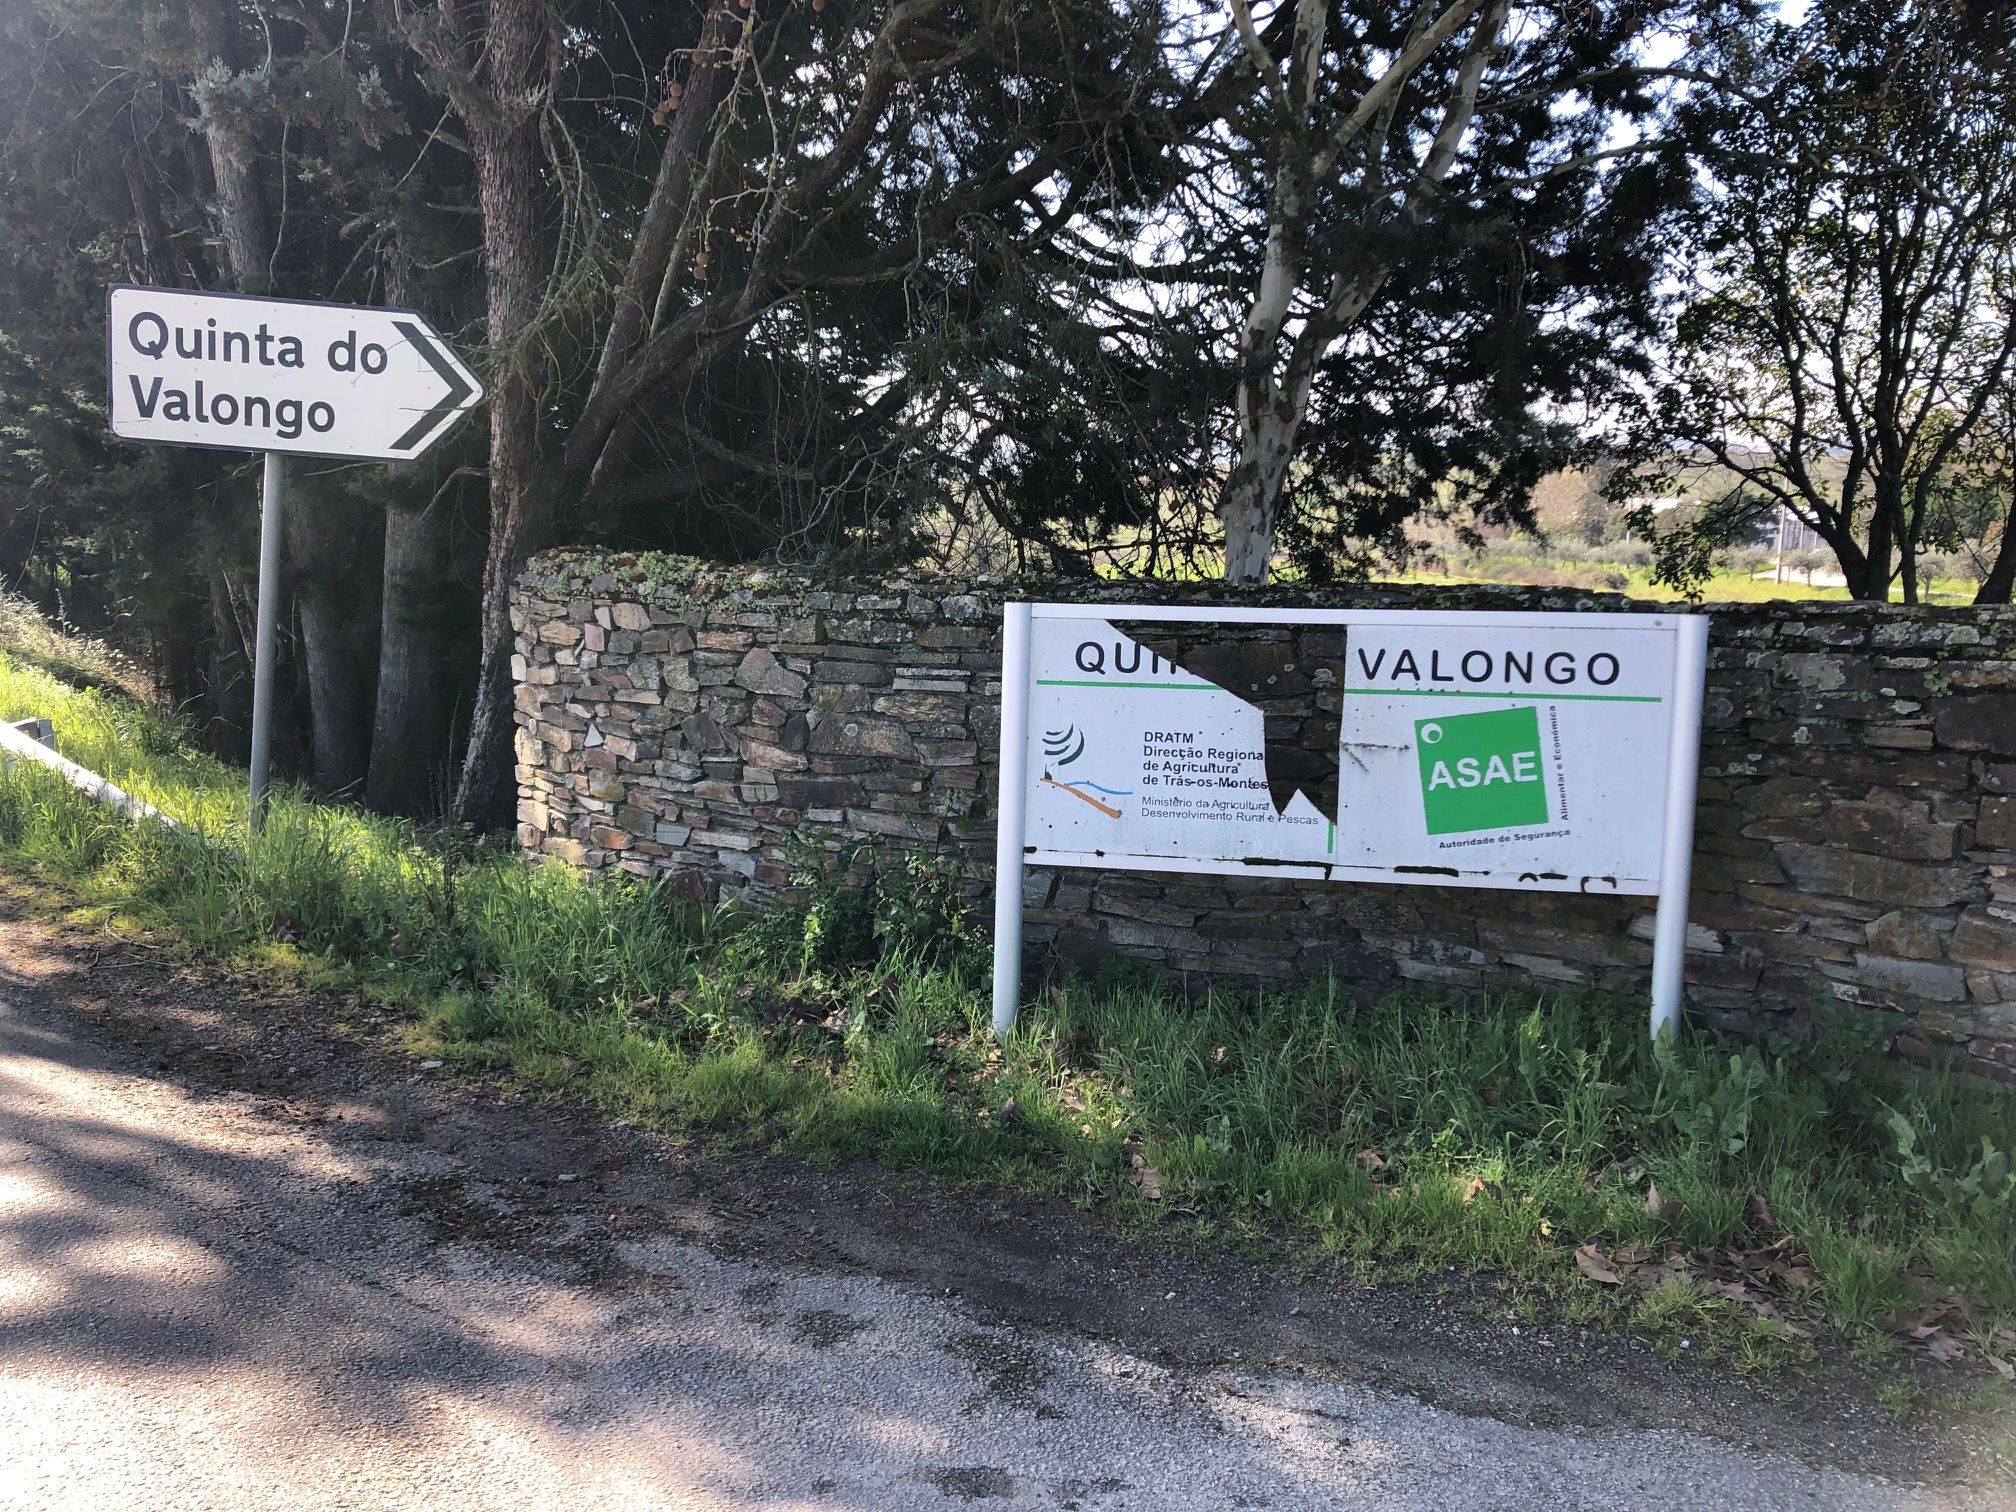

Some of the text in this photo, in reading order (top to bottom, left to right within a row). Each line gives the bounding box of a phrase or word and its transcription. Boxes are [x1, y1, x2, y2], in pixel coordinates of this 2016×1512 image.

[128, 311, 388, 375] Quinta do
[129, 374, 335, 439] Valongo
[1075, 641, 1620, 686] QUI VALONGO
[1144, 731, 1194, 744] DRATM
[1548, 705, 1562, 761] Económica
[1143, 745, 1264, 762] Direcção Regiona
[1143, 760, 1239, 775] de Agricultura
[1428, 751, 1538, 791] ASAE
[1142, 774, 1269, 790] de Trás-os-Montes
[1195, 798, 1210, 809] da
[1211, 799, 1270, 812] Agricultura
[1557, 772, 1569, 821] Alimentar
[1141, 807, 1319, 825] Desenvolvimento Rural e Pescas
[1438, 828, 1571, 850] Autoridade de Segurança
